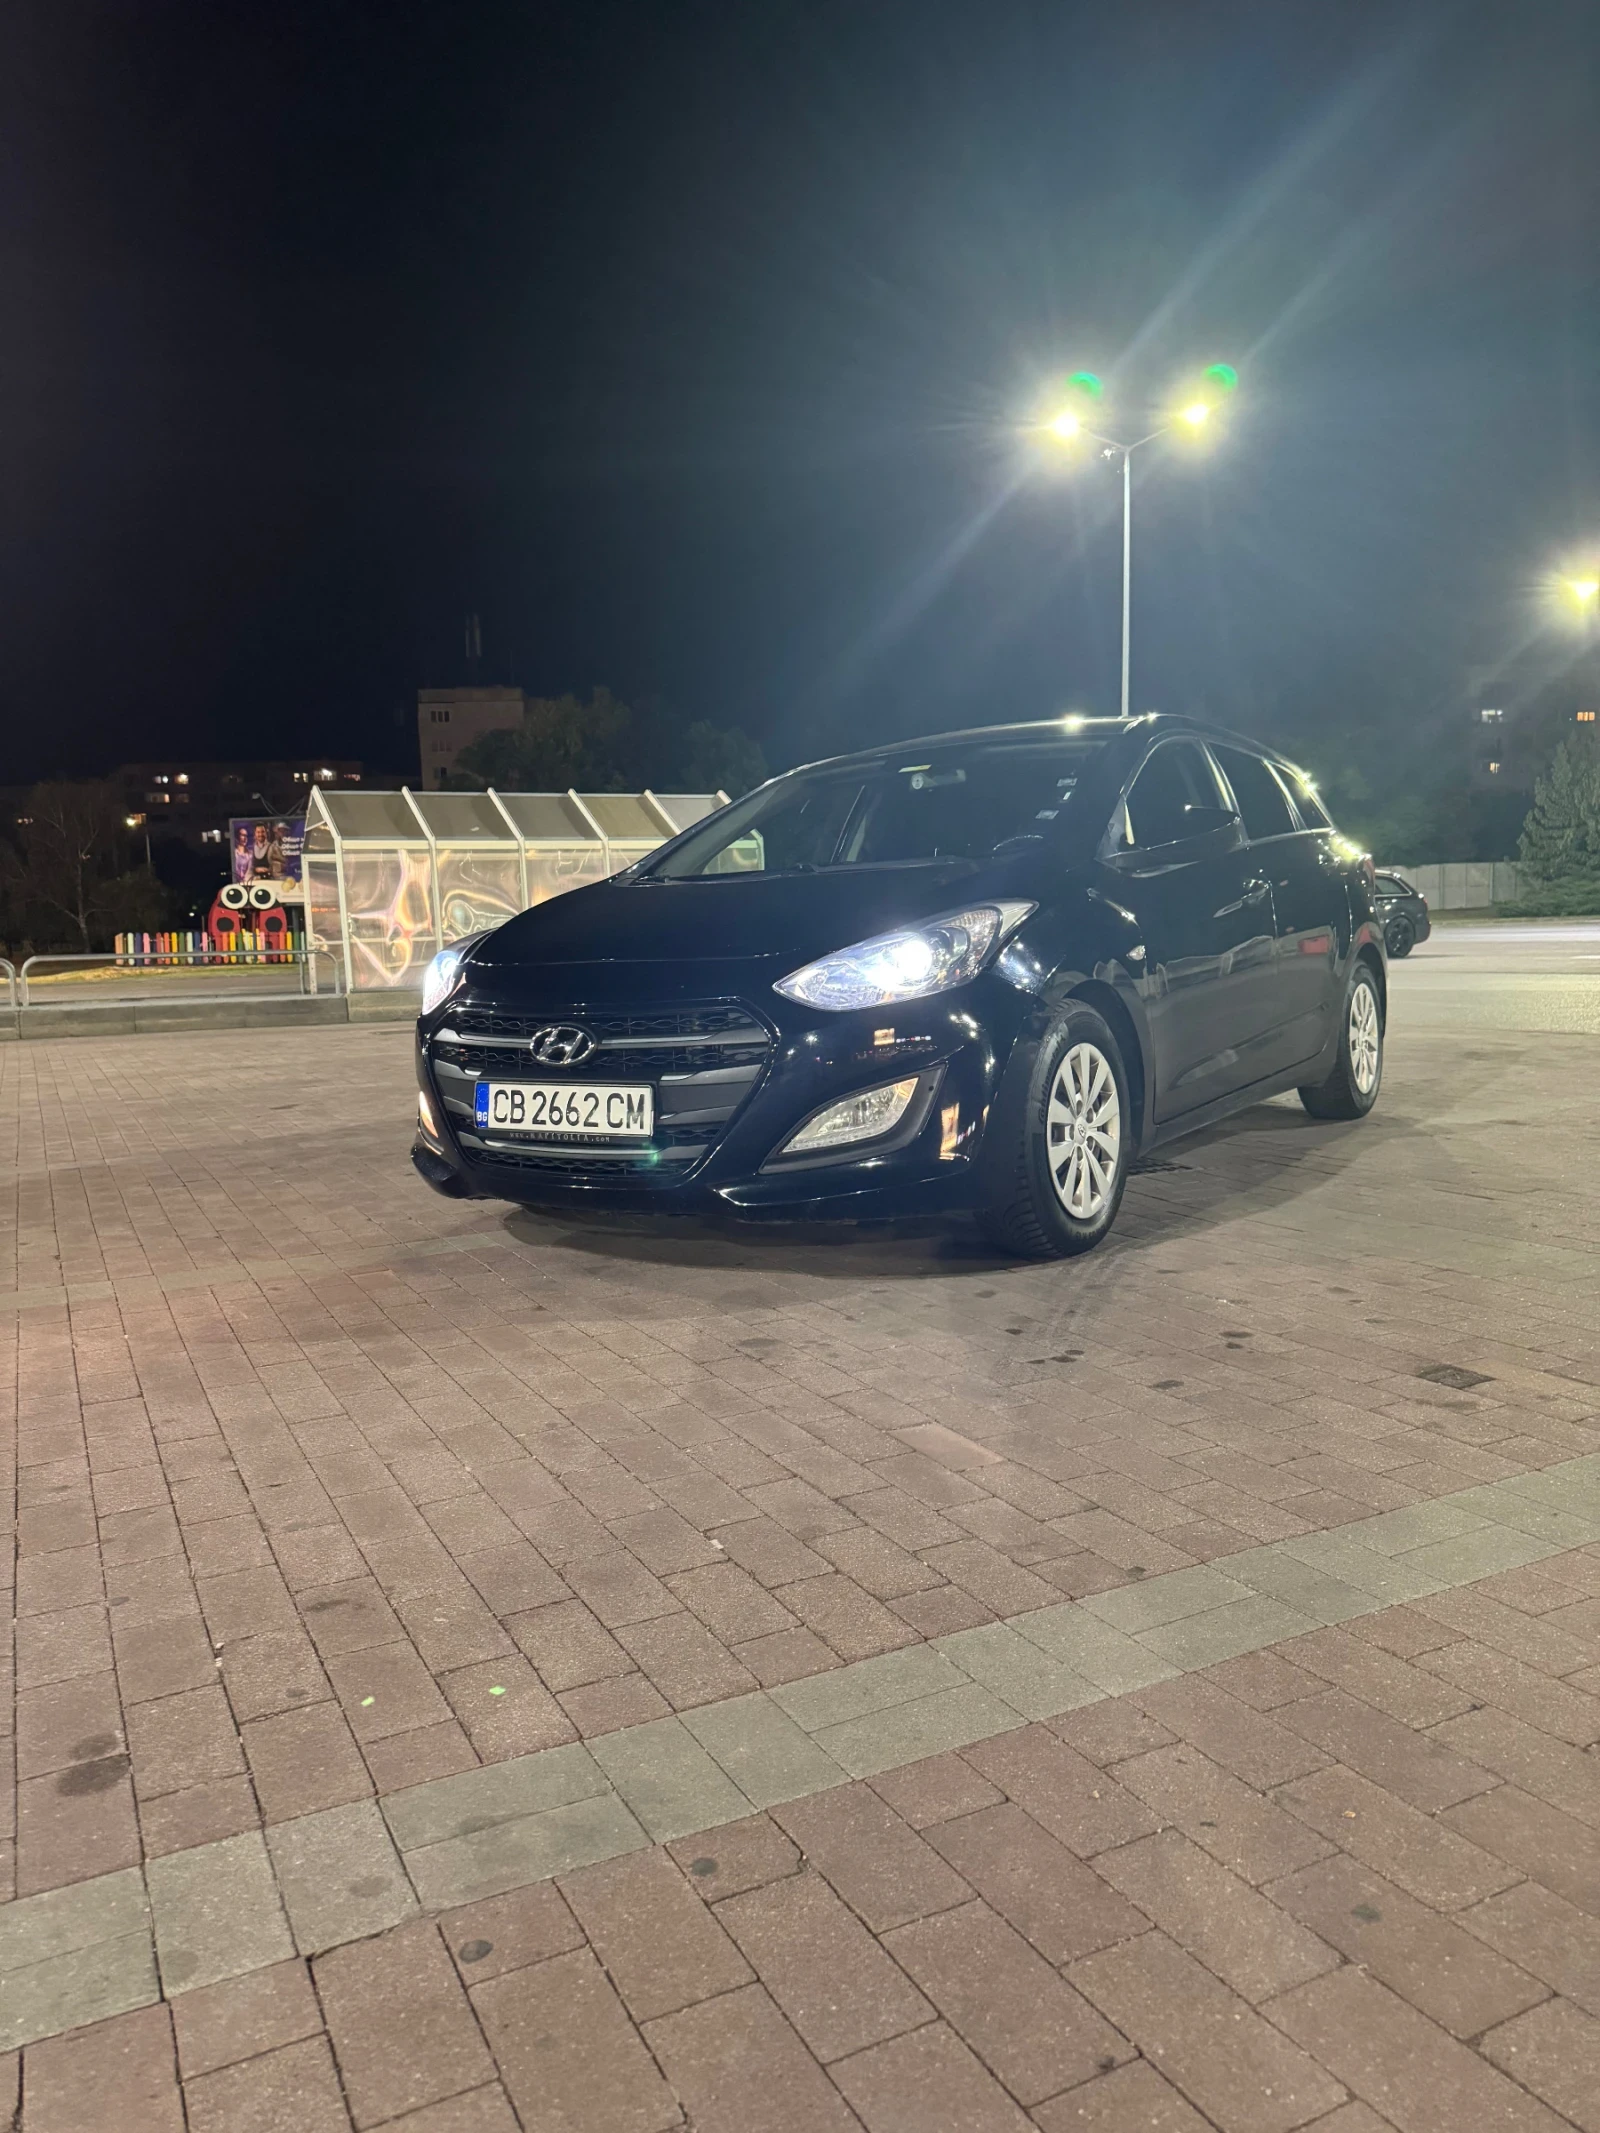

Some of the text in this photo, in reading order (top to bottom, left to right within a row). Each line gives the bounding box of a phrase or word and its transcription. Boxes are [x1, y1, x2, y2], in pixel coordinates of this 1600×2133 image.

[477, 1111, 488, 1122] BG
[494, 1089, 645, 1130] CB 2662 CM
